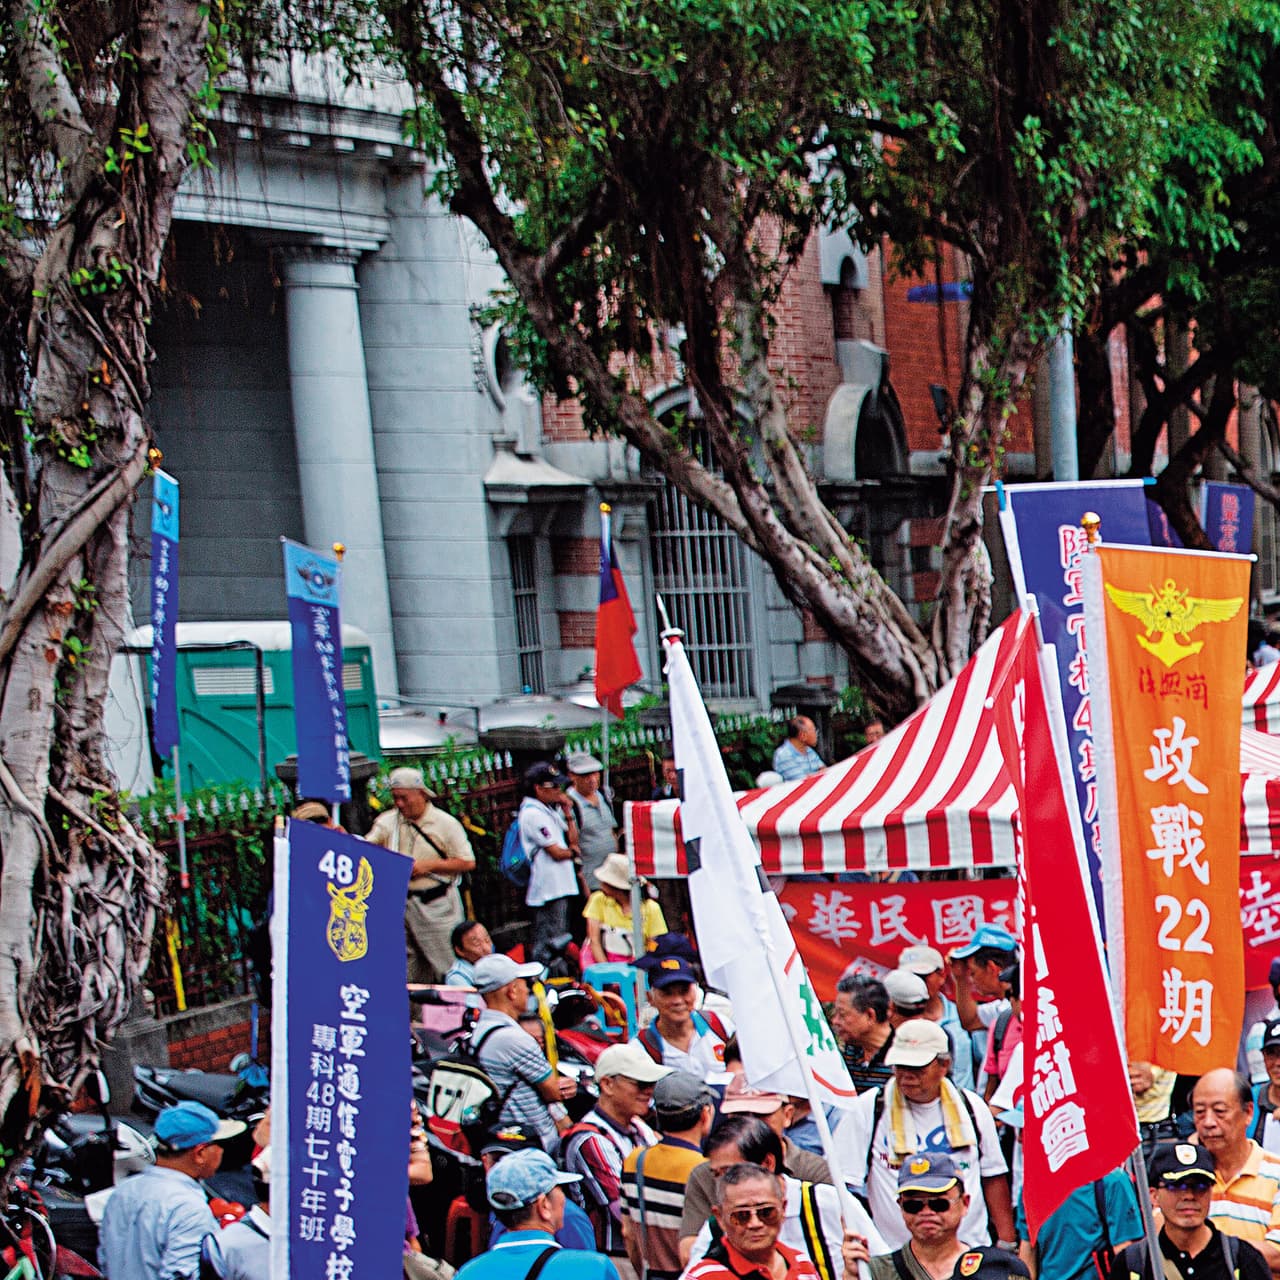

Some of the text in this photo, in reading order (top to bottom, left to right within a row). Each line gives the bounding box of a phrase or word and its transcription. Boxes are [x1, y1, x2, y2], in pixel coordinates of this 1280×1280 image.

[319, 849, 353, 885] 48
[1144, 717, 1213, 1048] 政戰22期
[299, 1022, 336, 1243] 專科48期七十年班
